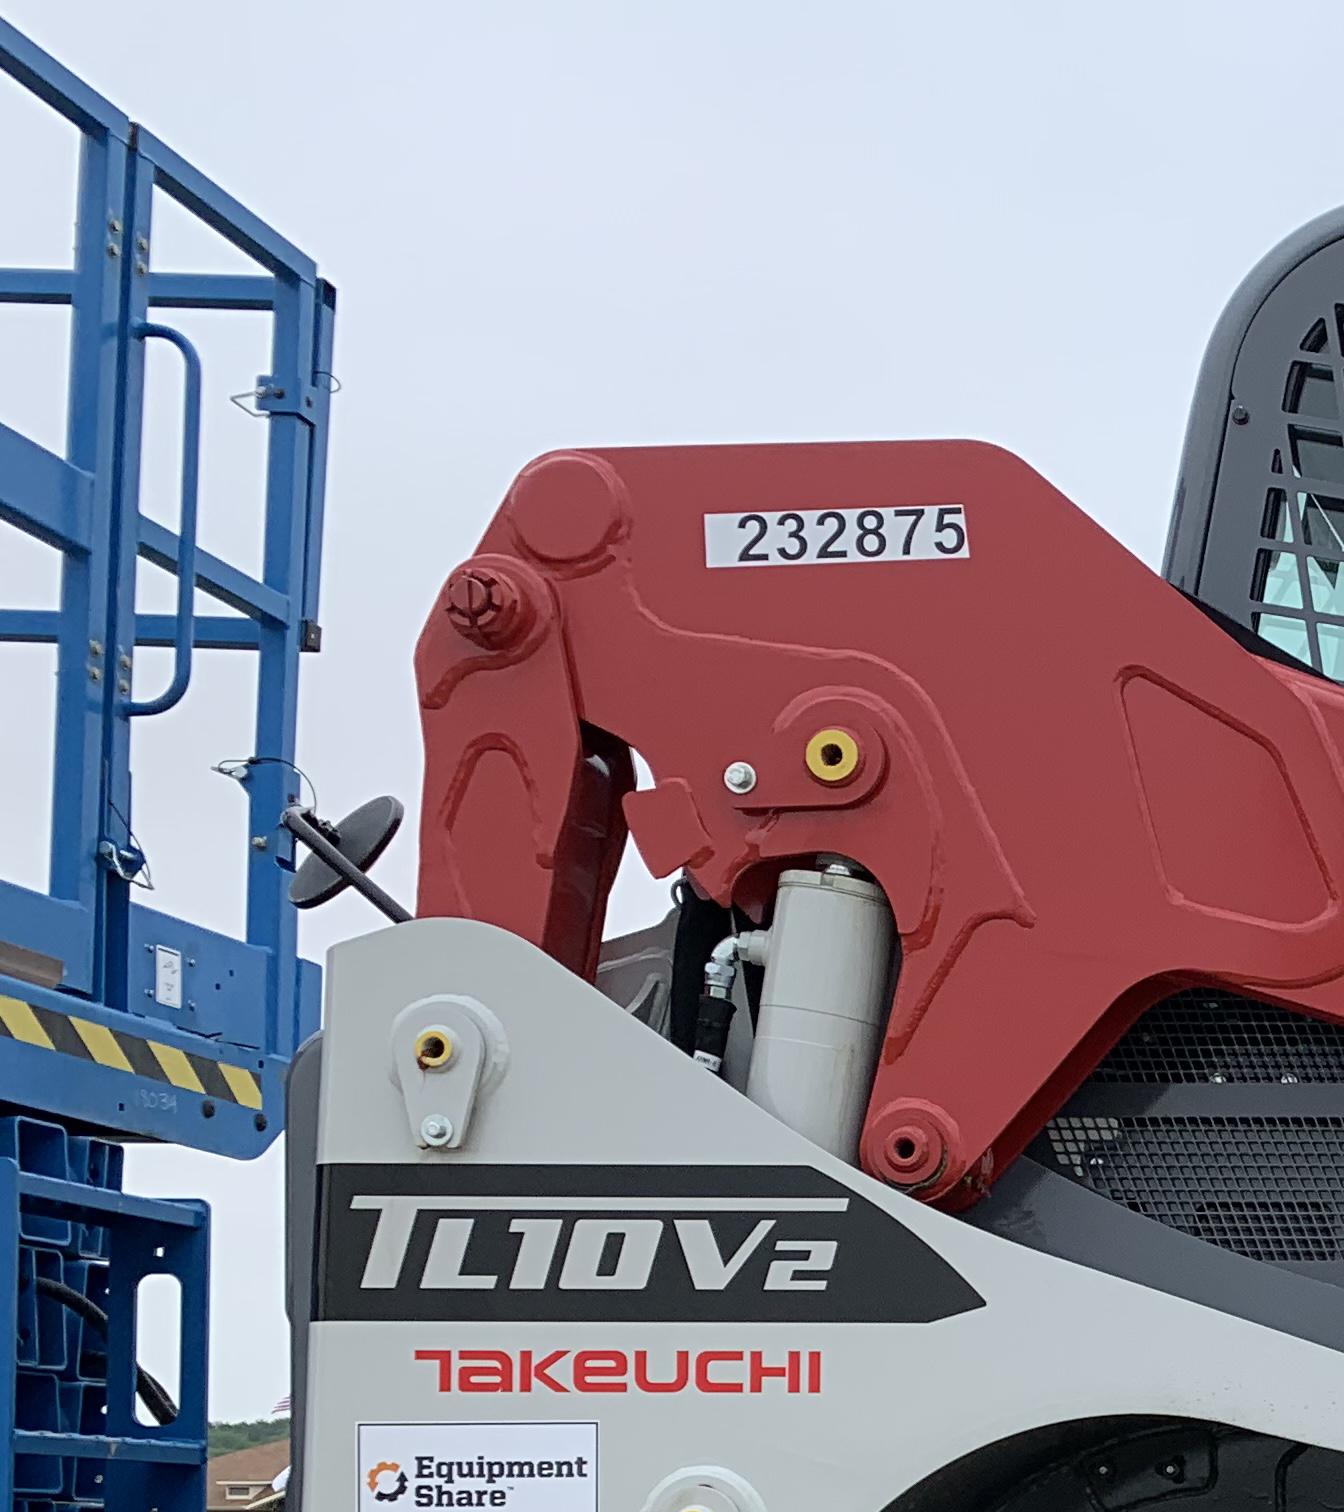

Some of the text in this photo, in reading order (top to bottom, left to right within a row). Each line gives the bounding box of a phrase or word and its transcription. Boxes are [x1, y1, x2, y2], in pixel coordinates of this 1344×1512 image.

[737, 507, 966, 562] 232875
[350, 1195, 849, 1290] TL10V2
[414, 1349, 822, 1394] TAKEUCHI
[414, 1456, 588, 1483] Equipment
[415, 1484, 506, 1508] Share
